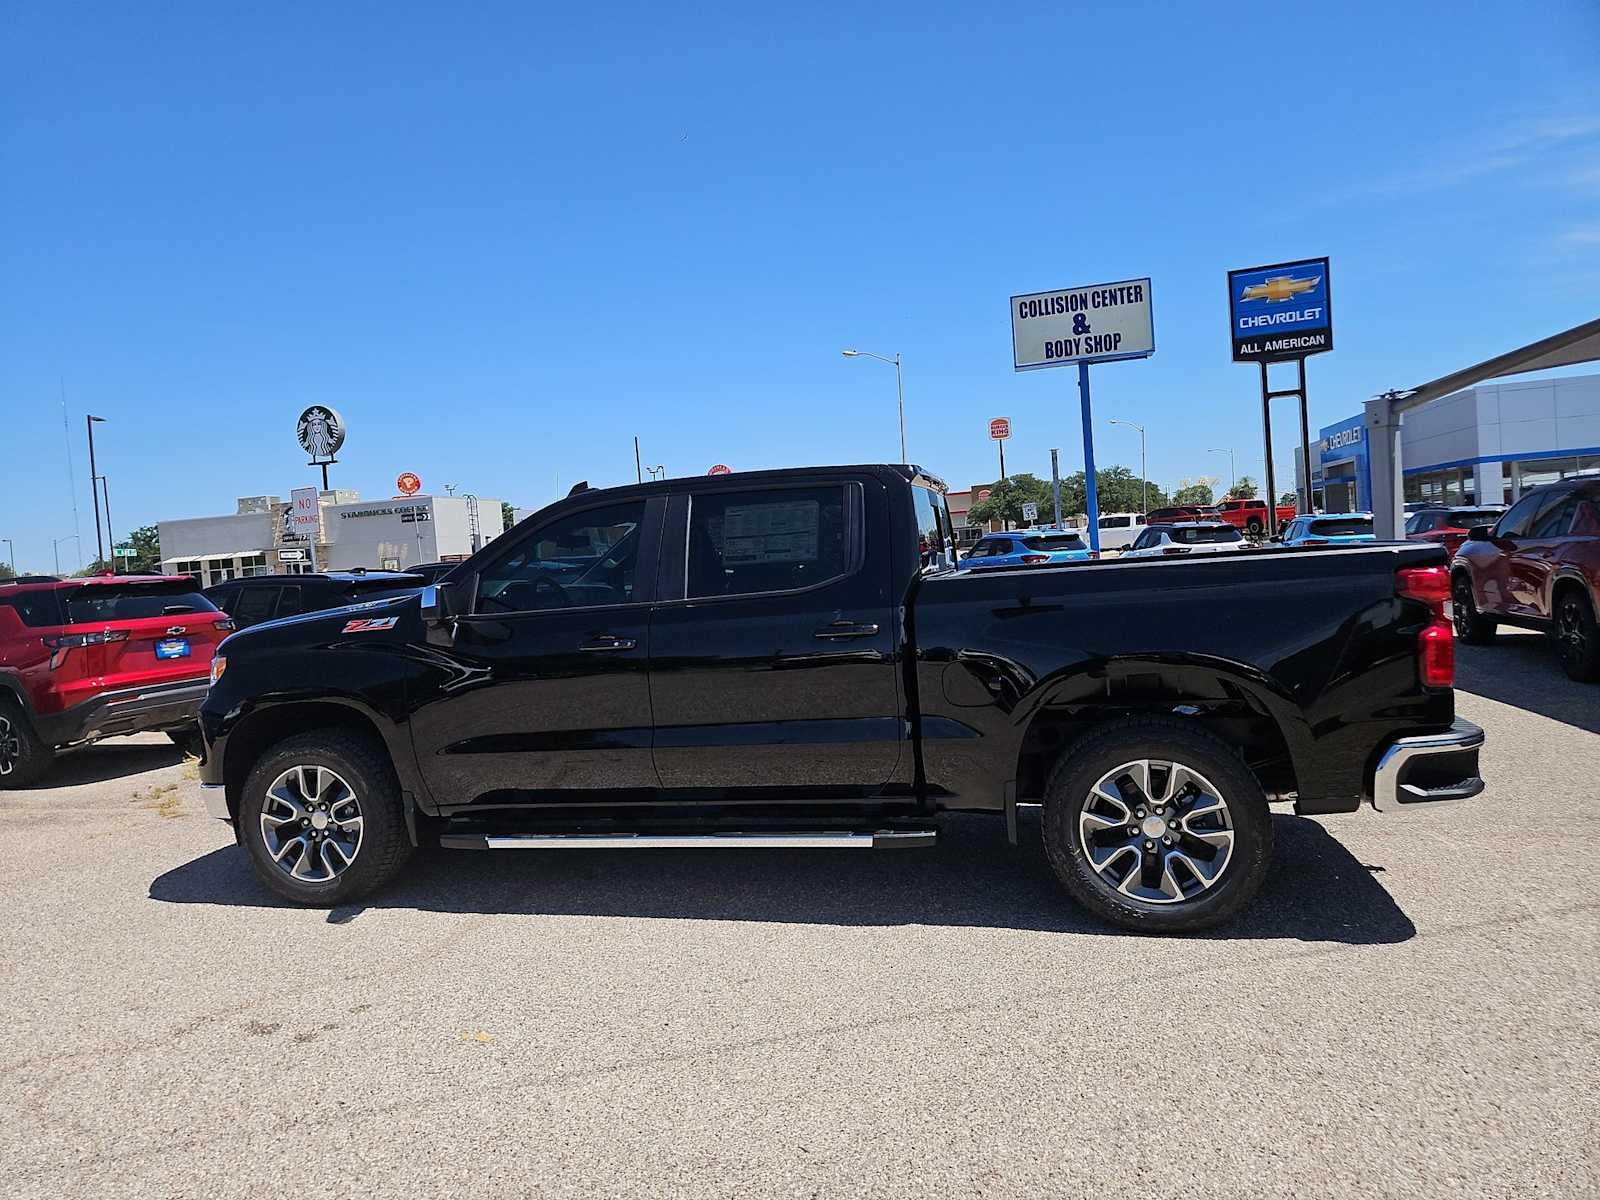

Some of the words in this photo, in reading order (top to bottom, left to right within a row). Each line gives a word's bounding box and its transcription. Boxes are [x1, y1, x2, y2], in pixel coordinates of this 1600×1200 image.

[1019, 292, 1088, 319] COLLISION
[1092, 284, 1143, 308] CENTER
[1072, 313, 1091, 336] &
[1240, 307, 1322, 328] CHEVROLET
[1045, 338, 1081, 359] BODY
[1085, 333, 1122, 355] SHOP
[1240, 343, 1261, 354] ALL
[1264, 335, 1325, 352] AMERICAN
[1329, 426, 1361, 450] CHEVROLET
[298, 498, 310, 509] NO
[294, 514, 318, 524] PARKING
[341, 616, 400, 633] Z71
